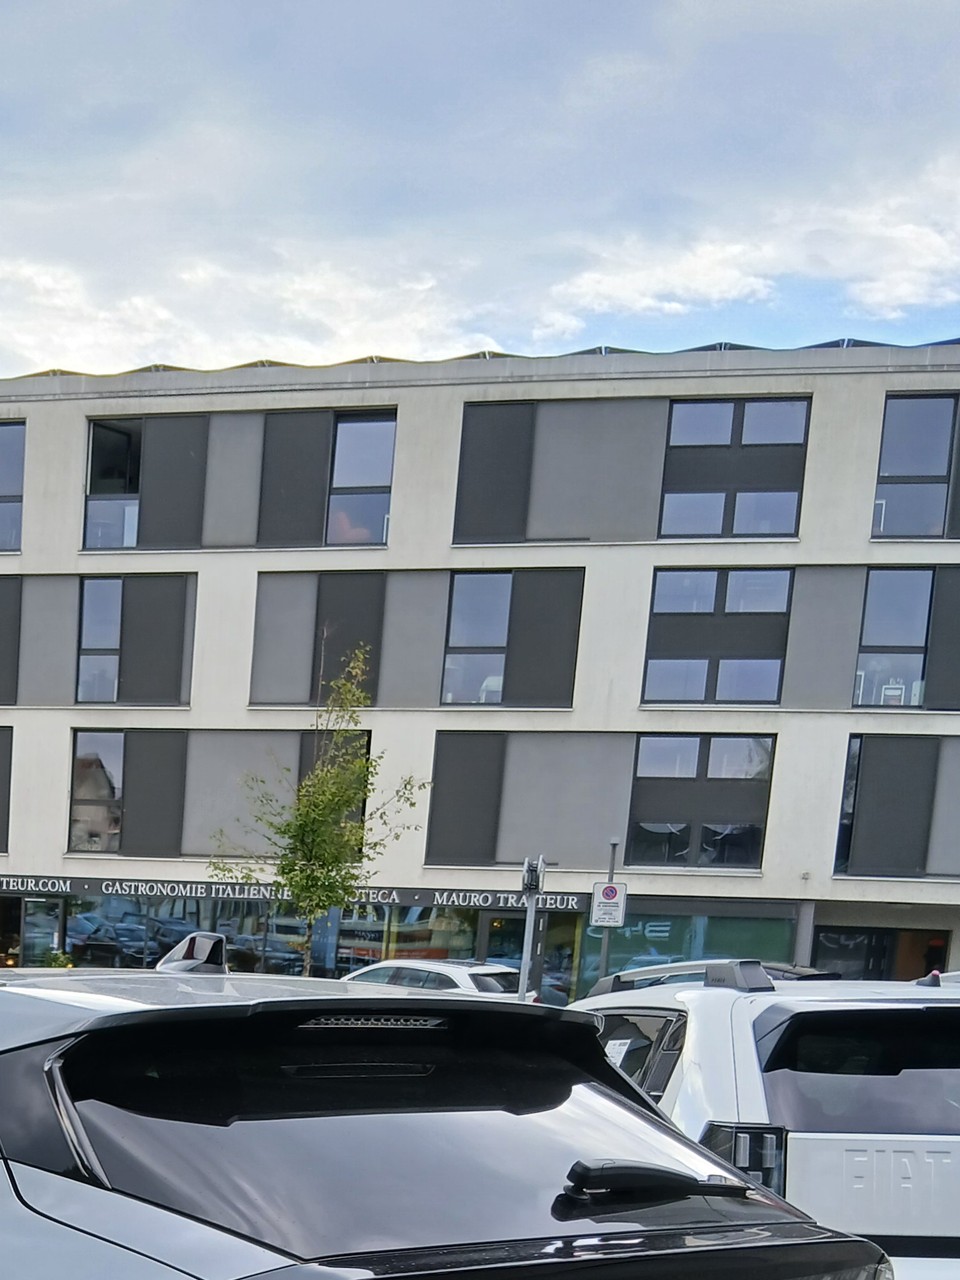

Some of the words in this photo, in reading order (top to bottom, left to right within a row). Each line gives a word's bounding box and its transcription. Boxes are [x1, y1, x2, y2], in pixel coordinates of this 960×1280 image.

[101, 881, 207, 898] GASTRONOMIE
[433, 891, 492, 907] MAURO
[496, 893, 578, 910] TRATEUR
[843, 1148, 952, 1208] FIAT
